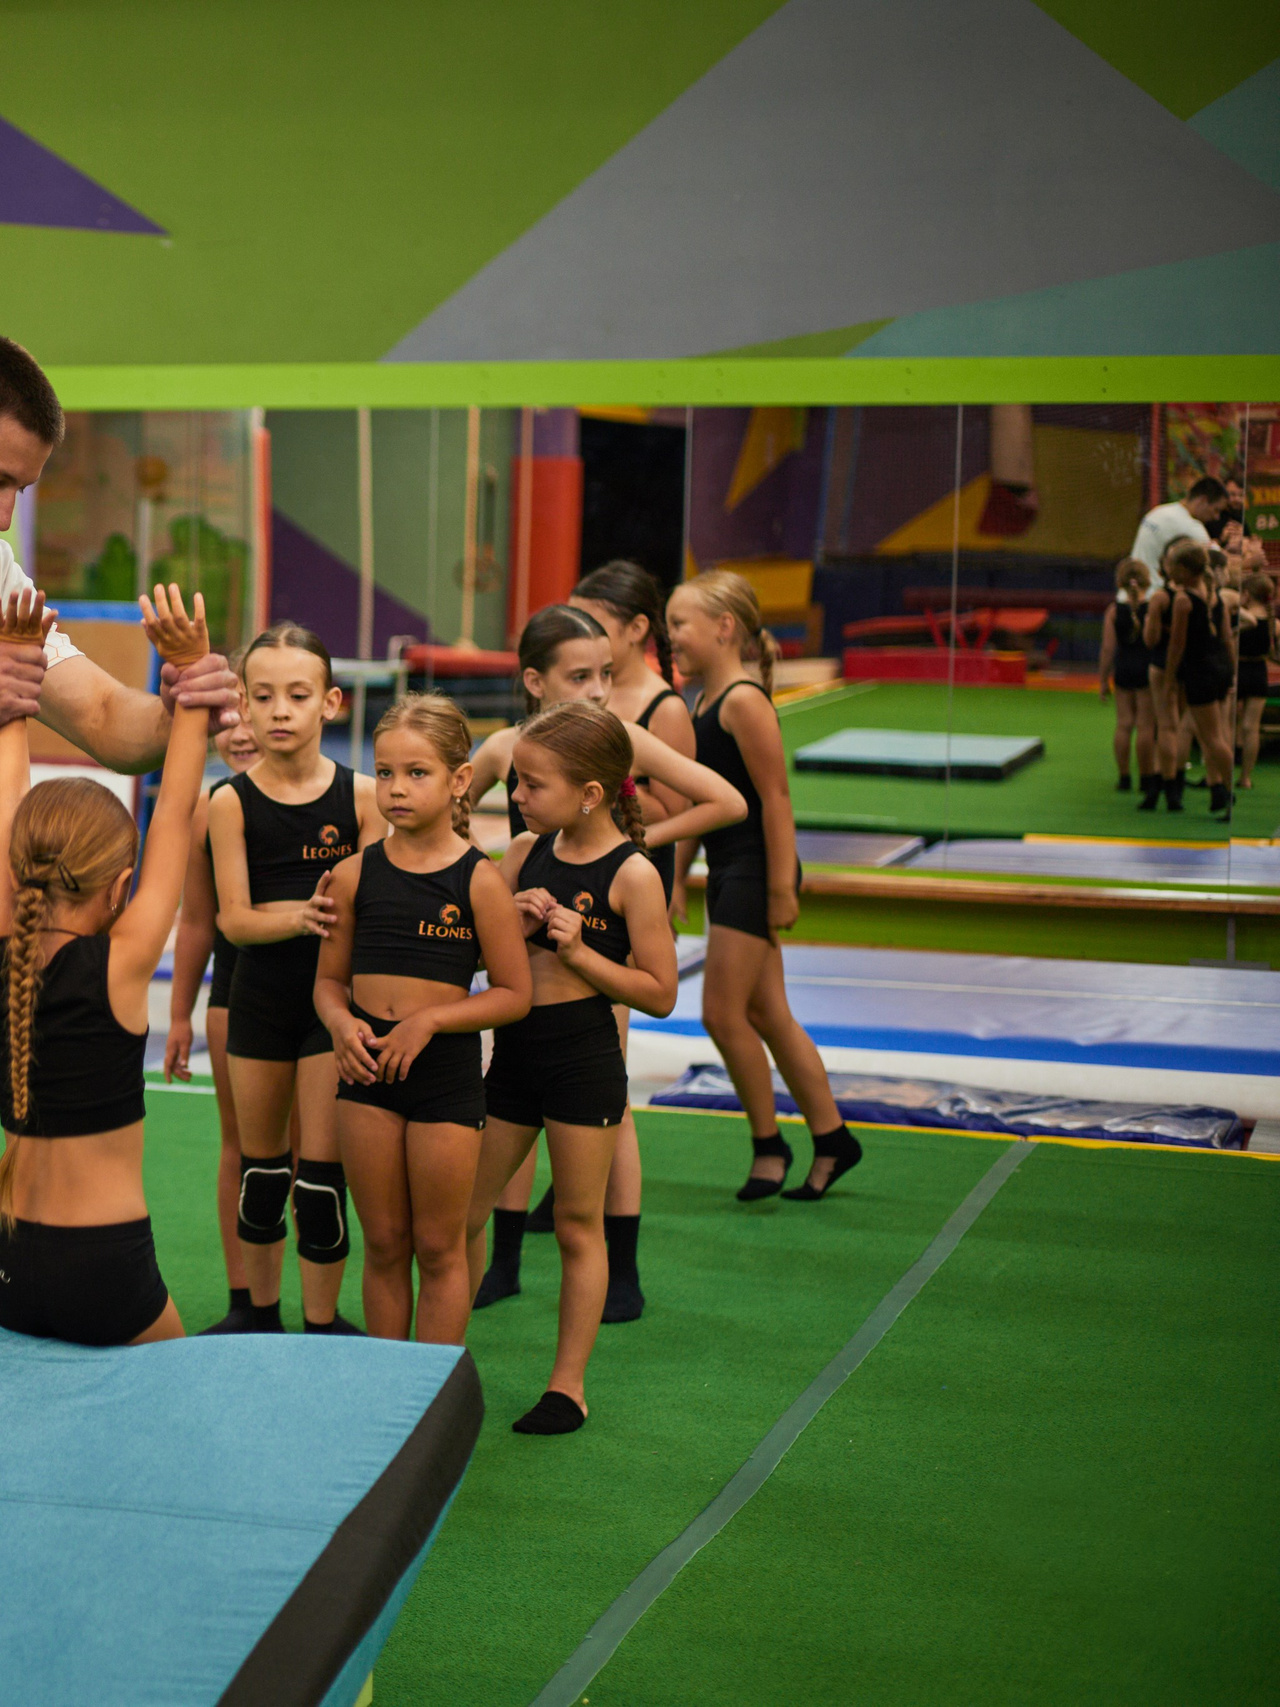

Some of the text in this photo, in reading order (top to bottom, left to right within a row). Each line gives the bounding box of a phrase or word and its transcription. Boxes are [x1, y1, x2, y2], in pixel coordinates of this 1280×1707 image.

[303, 844, 352, 860] LEONES
[418, 920, 473, 940] LEONES
[581, 914, 608, 931] NES
